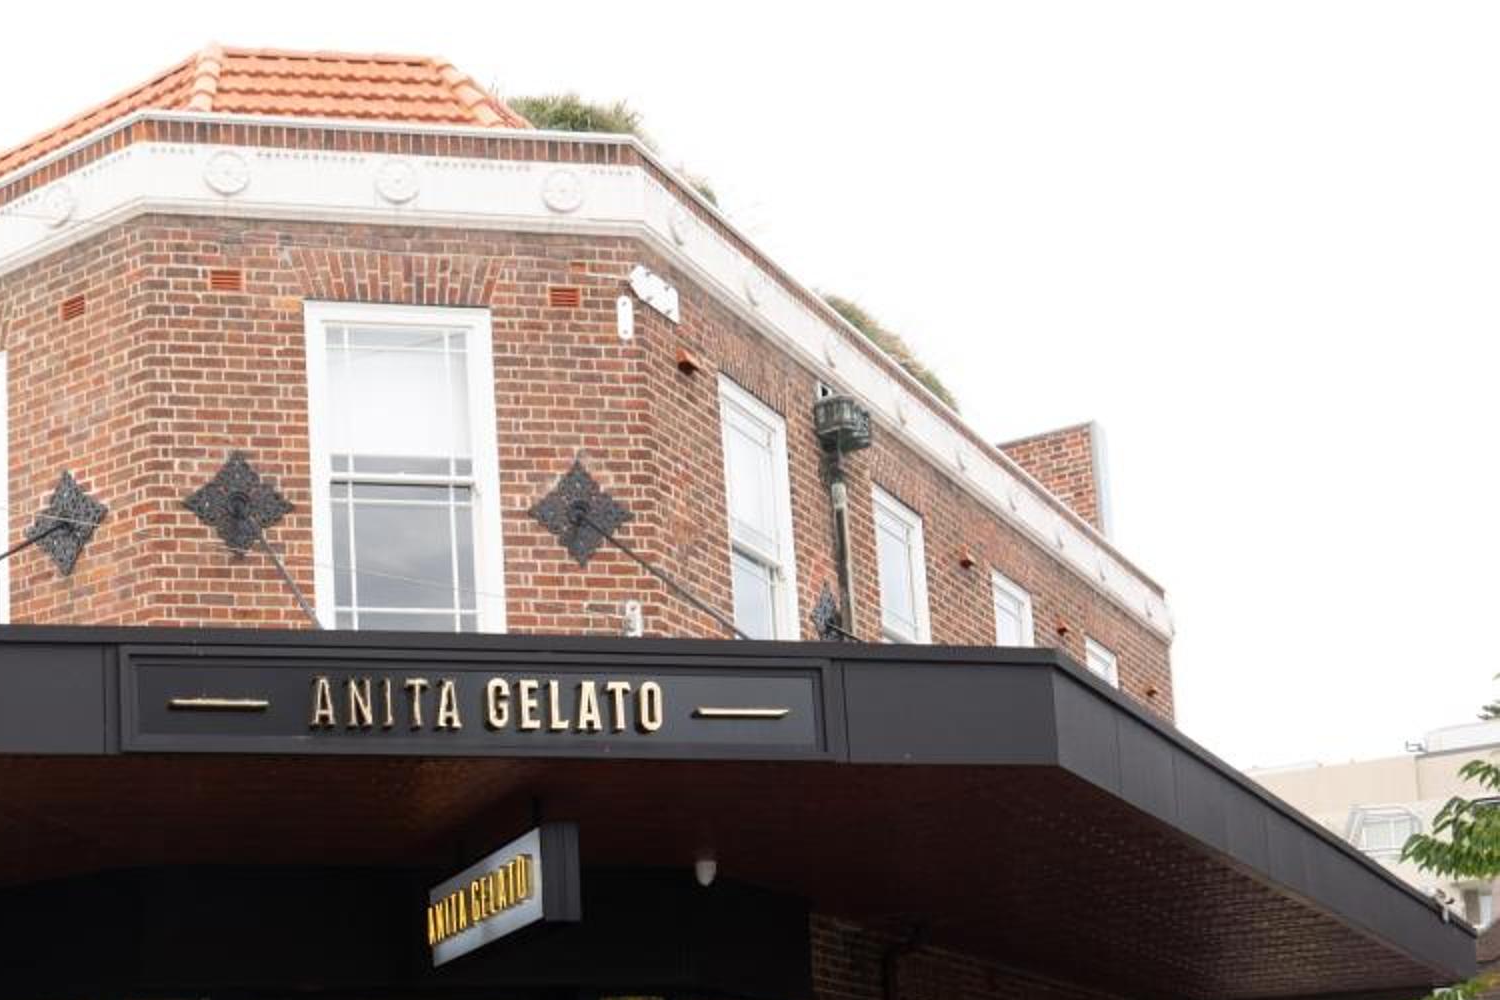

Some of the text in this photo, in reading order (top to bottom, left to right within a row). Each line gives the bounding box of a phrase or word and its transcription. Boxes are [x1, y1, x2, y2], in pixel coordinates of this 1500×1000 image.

[309, 676, 664, 732] ANITA GELATO
[427, 855, 530, 944] ANITA GELATO
